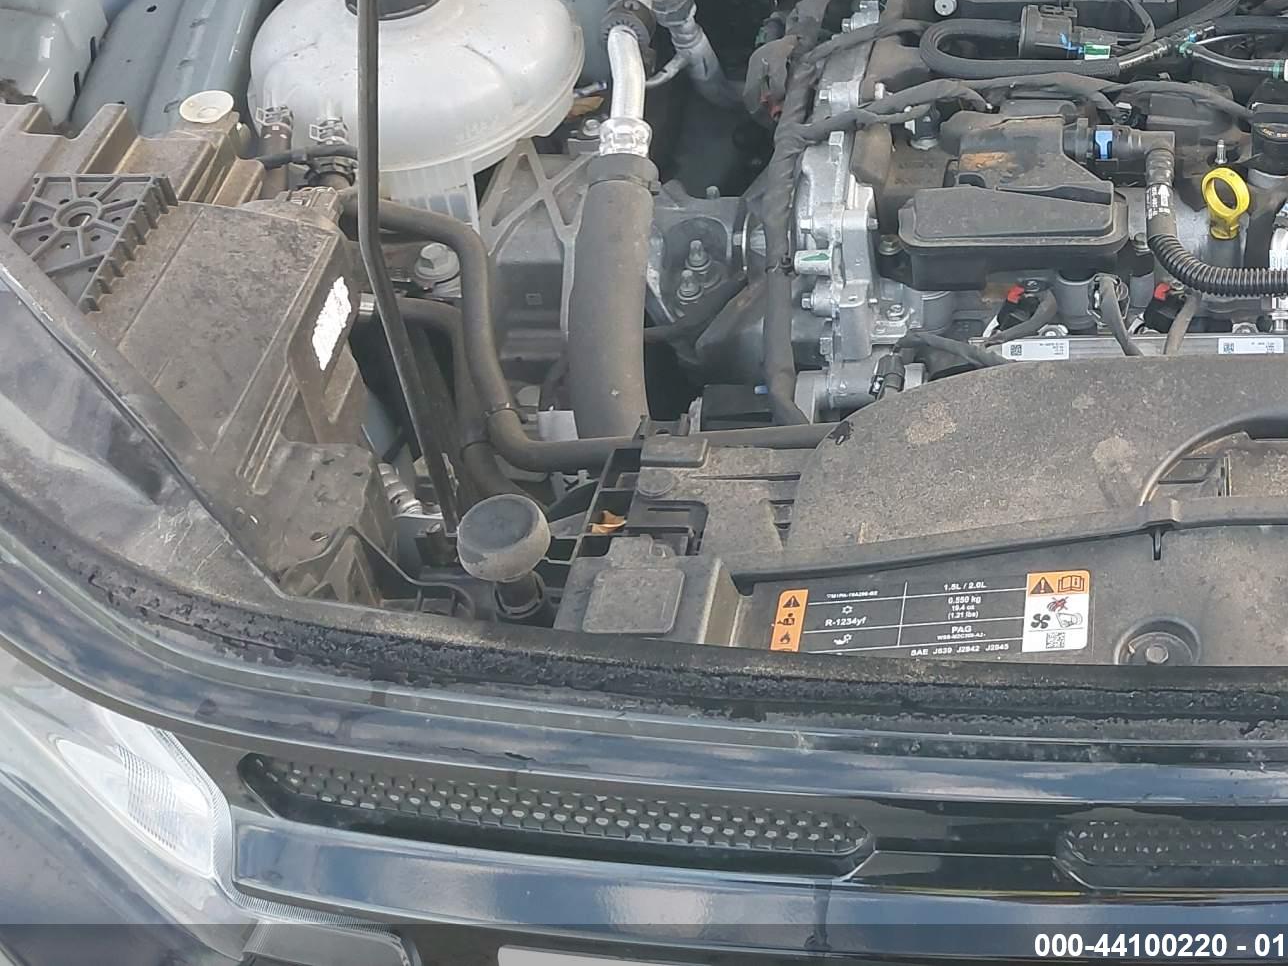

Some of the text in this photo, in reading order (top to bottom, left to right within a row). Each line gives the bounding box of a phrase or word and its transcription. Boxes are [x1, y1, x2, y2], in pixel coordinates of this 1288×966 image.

[944, 583, 961, 591] 1.5L
[968, 581, 987, 589] 2.0L
[948, 596, 982, 604] 0.550 kg
[825, 616, 867, 626] R-1234yf
[951, 625, 972, 633] PAG
[933, 647, 952, 655] J639
